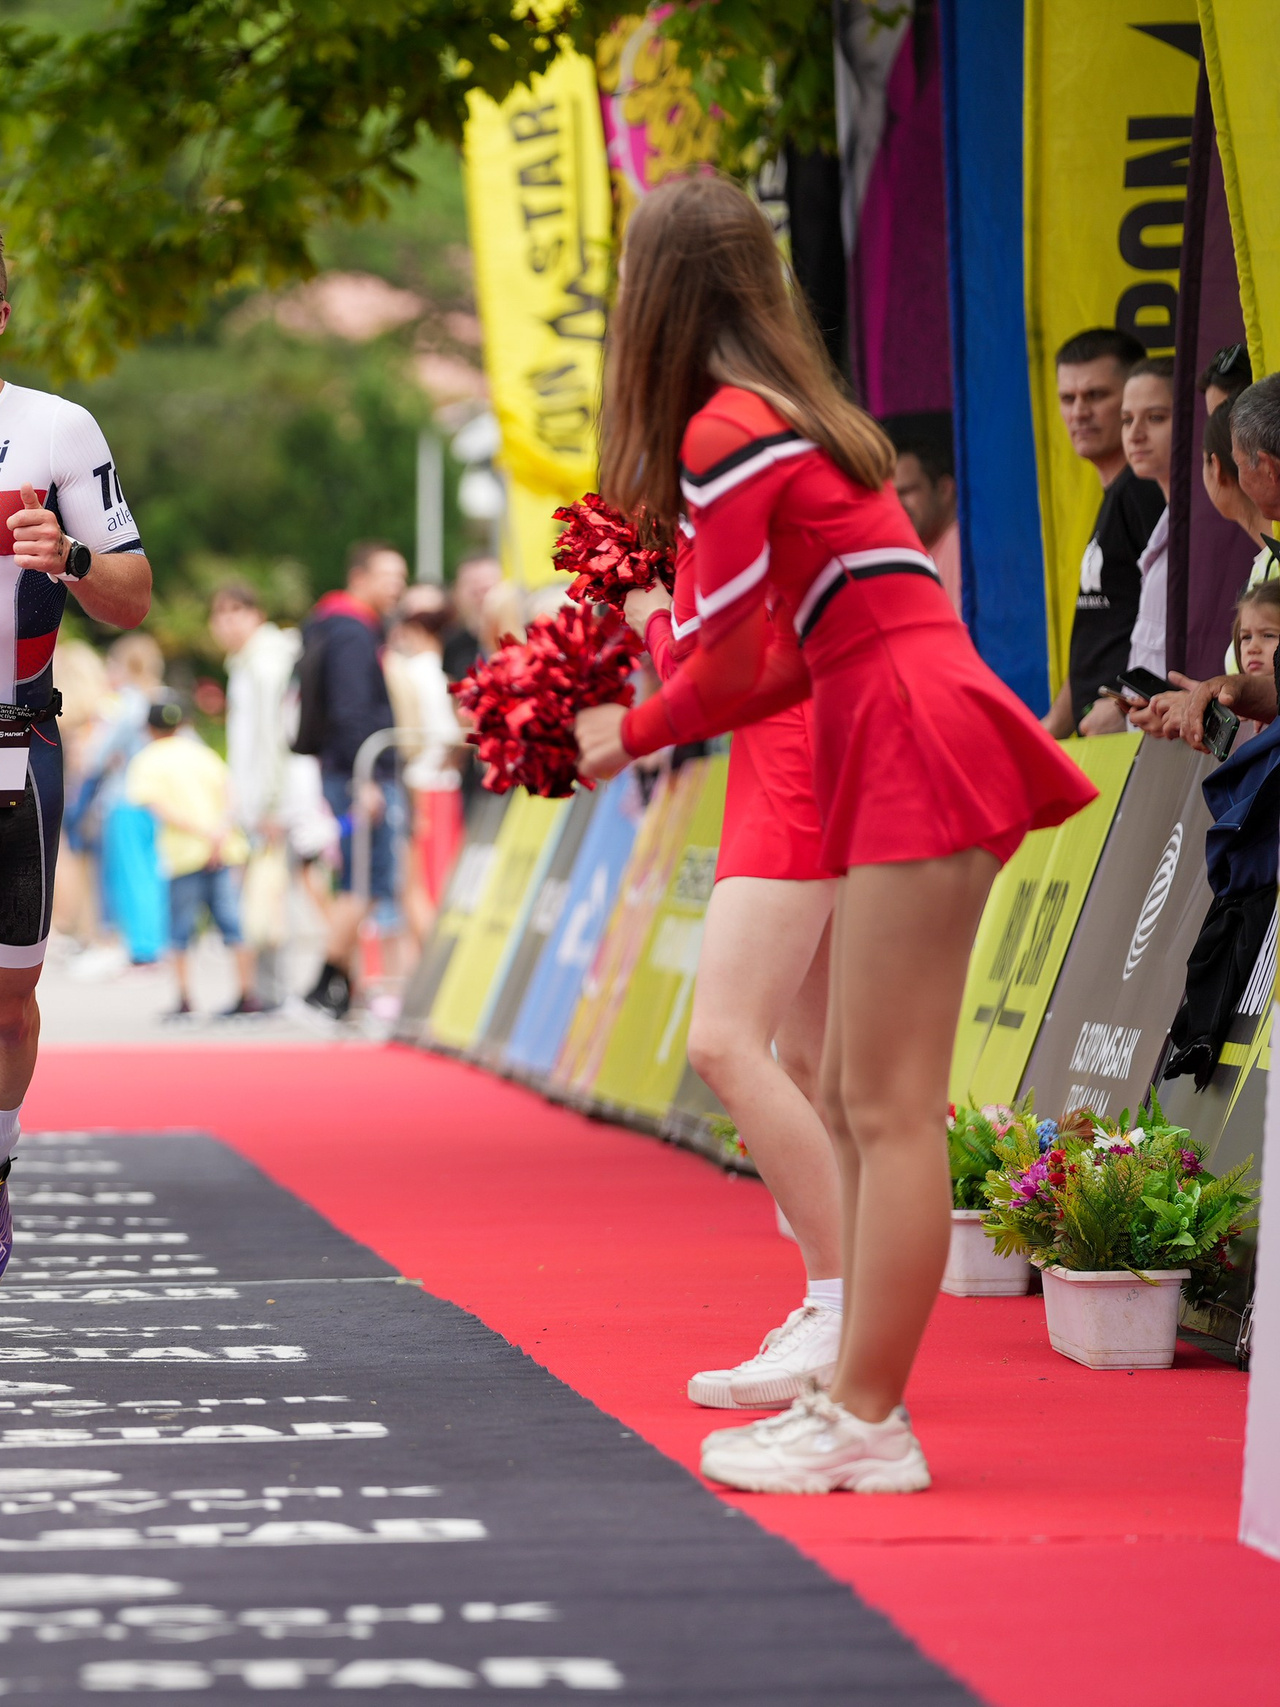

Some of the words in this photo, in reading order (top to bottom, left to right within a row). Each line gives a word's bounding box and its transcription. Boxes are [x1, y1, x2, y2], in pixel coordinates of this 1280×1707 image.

[107, 508, 133, 532] atle
[1, 1421, 390, 1443] STAR
[39, 1517, 487, 1548] STAR
